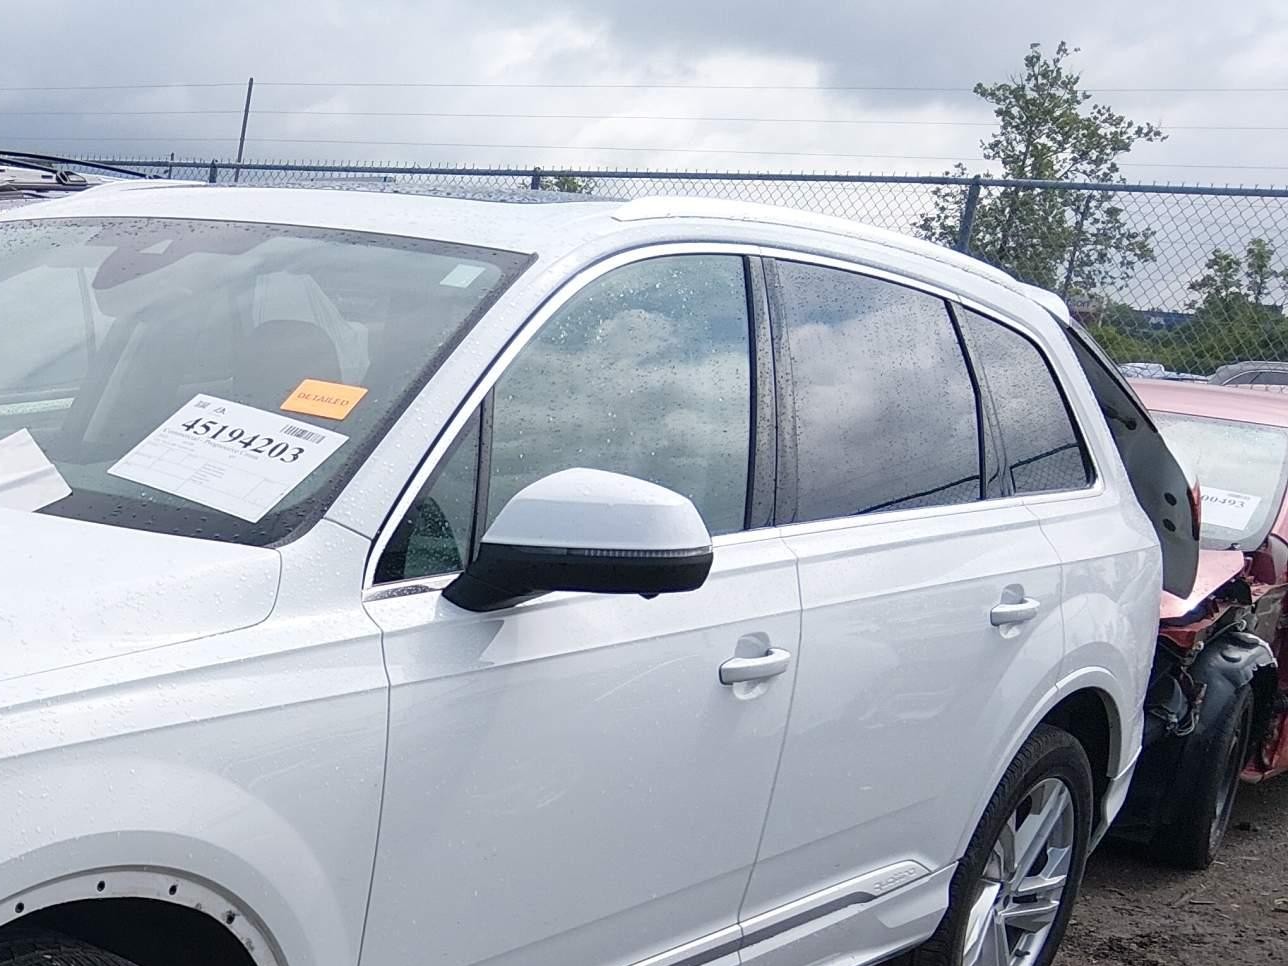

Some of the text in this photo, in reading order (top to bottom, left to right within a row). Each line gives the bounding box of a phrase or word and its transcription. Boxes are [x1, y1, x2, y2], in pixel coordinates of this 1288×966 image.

[297, 392, 350, 406] DETAILED
[181, 417, 305, 464] 45194203
[1200, 494, 1246, 508] 00493
